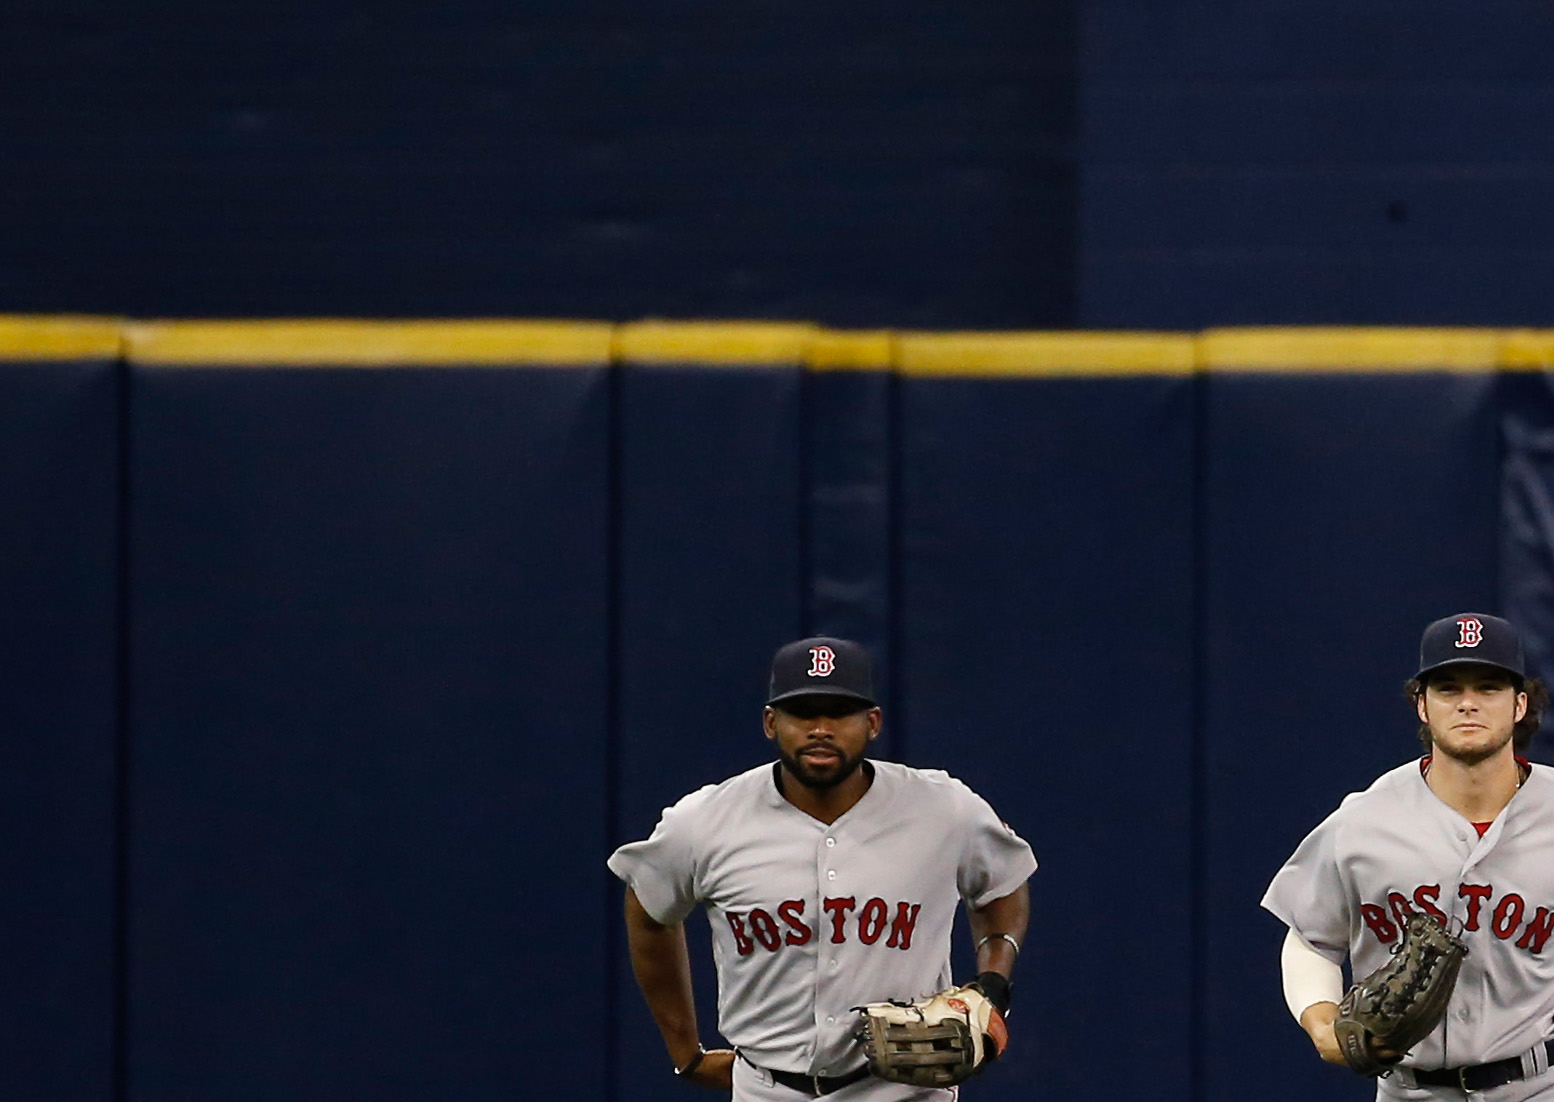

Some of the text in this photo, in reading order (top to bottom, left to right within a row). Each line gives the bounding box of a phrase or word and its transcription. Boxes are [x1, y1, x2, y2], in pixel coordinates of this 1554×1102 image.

[1455, 617, 1483, 648] B
[807, 645, 836, 677] B
[726, 896, 922, 956] BOSTON
